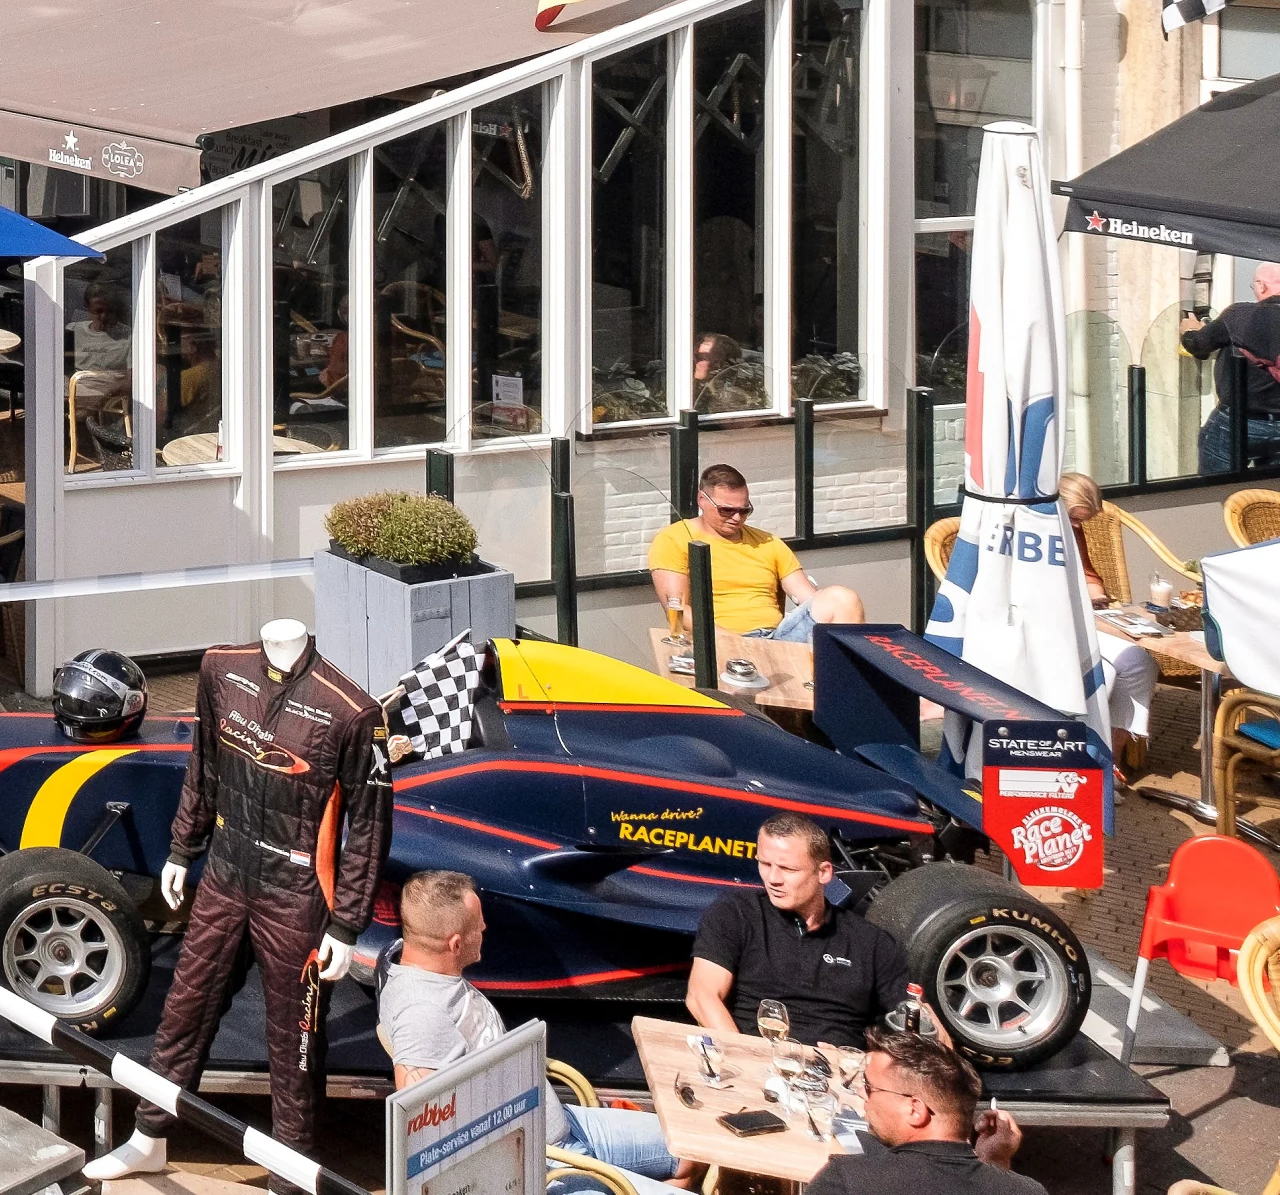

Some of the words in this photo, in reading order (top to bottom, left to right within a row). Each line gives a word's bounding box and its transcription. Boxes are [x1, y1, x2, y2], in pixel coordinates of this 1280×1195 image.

[49, 147, 92, 170] Heineken
[1107, 217, 1195, 245] Heineken
[988, 738, 1039, 750] STATE
[1039, 740, 1052, 748] OF
[1053, 741, 1086, 752] ART
[1009, 750, 1062, 758] MENSWEAR
[610, 809, 659, 822] Wanna
[660, 807, 703, 820] drive?
[1011, 816, 1063, 849] Race
[1023, 823, 1093, 864] Planet
[992, 907, 1078, 962] KUMHO
[407, 1093, 457, 1136] rabbel
[419, 1129, 470, 1168] Plate-service
[470, 1116, 491, 1139] vanaf
[492, 1104, 514, 1125] 12.00
[513, 1098, 528, 1113] uur
